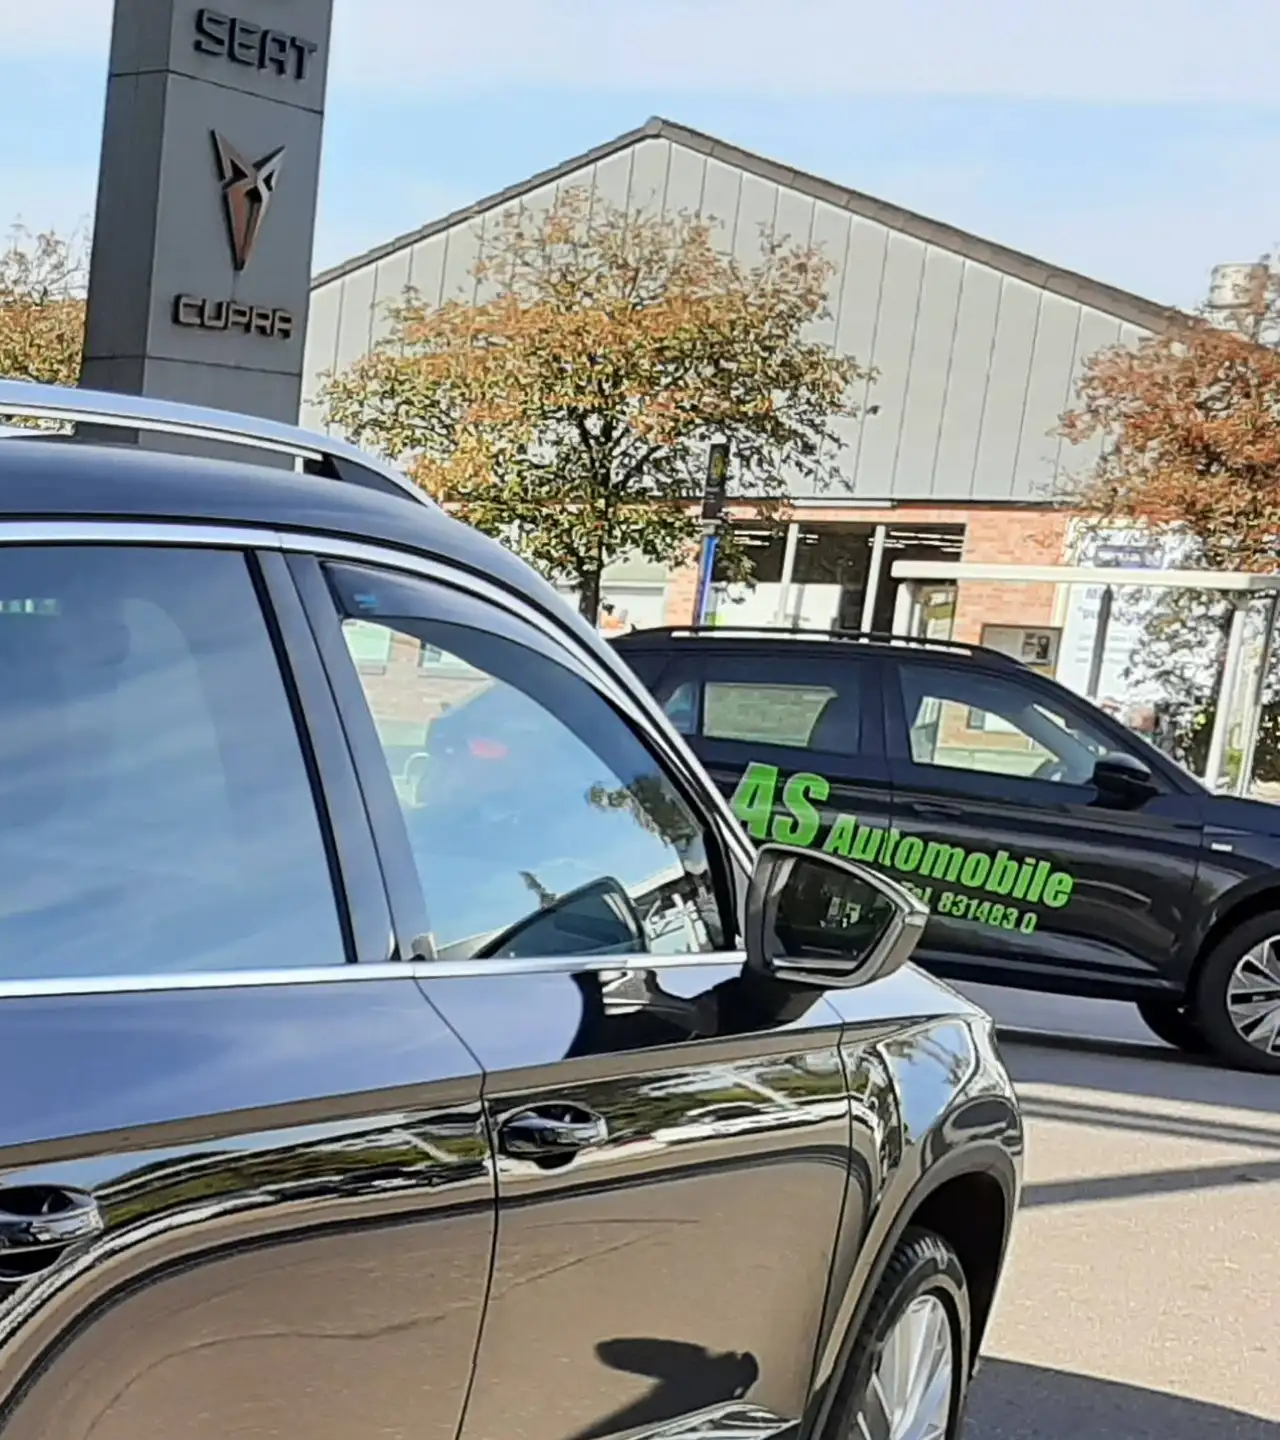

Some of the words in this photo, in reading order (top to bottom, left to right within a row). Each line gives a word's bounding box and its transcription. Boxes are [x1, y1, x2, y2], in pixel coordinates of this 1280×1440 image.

[194, 8, 318, 79] SEAT
[173, 293, 294, 340] CUPRA
[729, 761, 831, 846] AS
[823, 814, 1075, 909] Automobile
